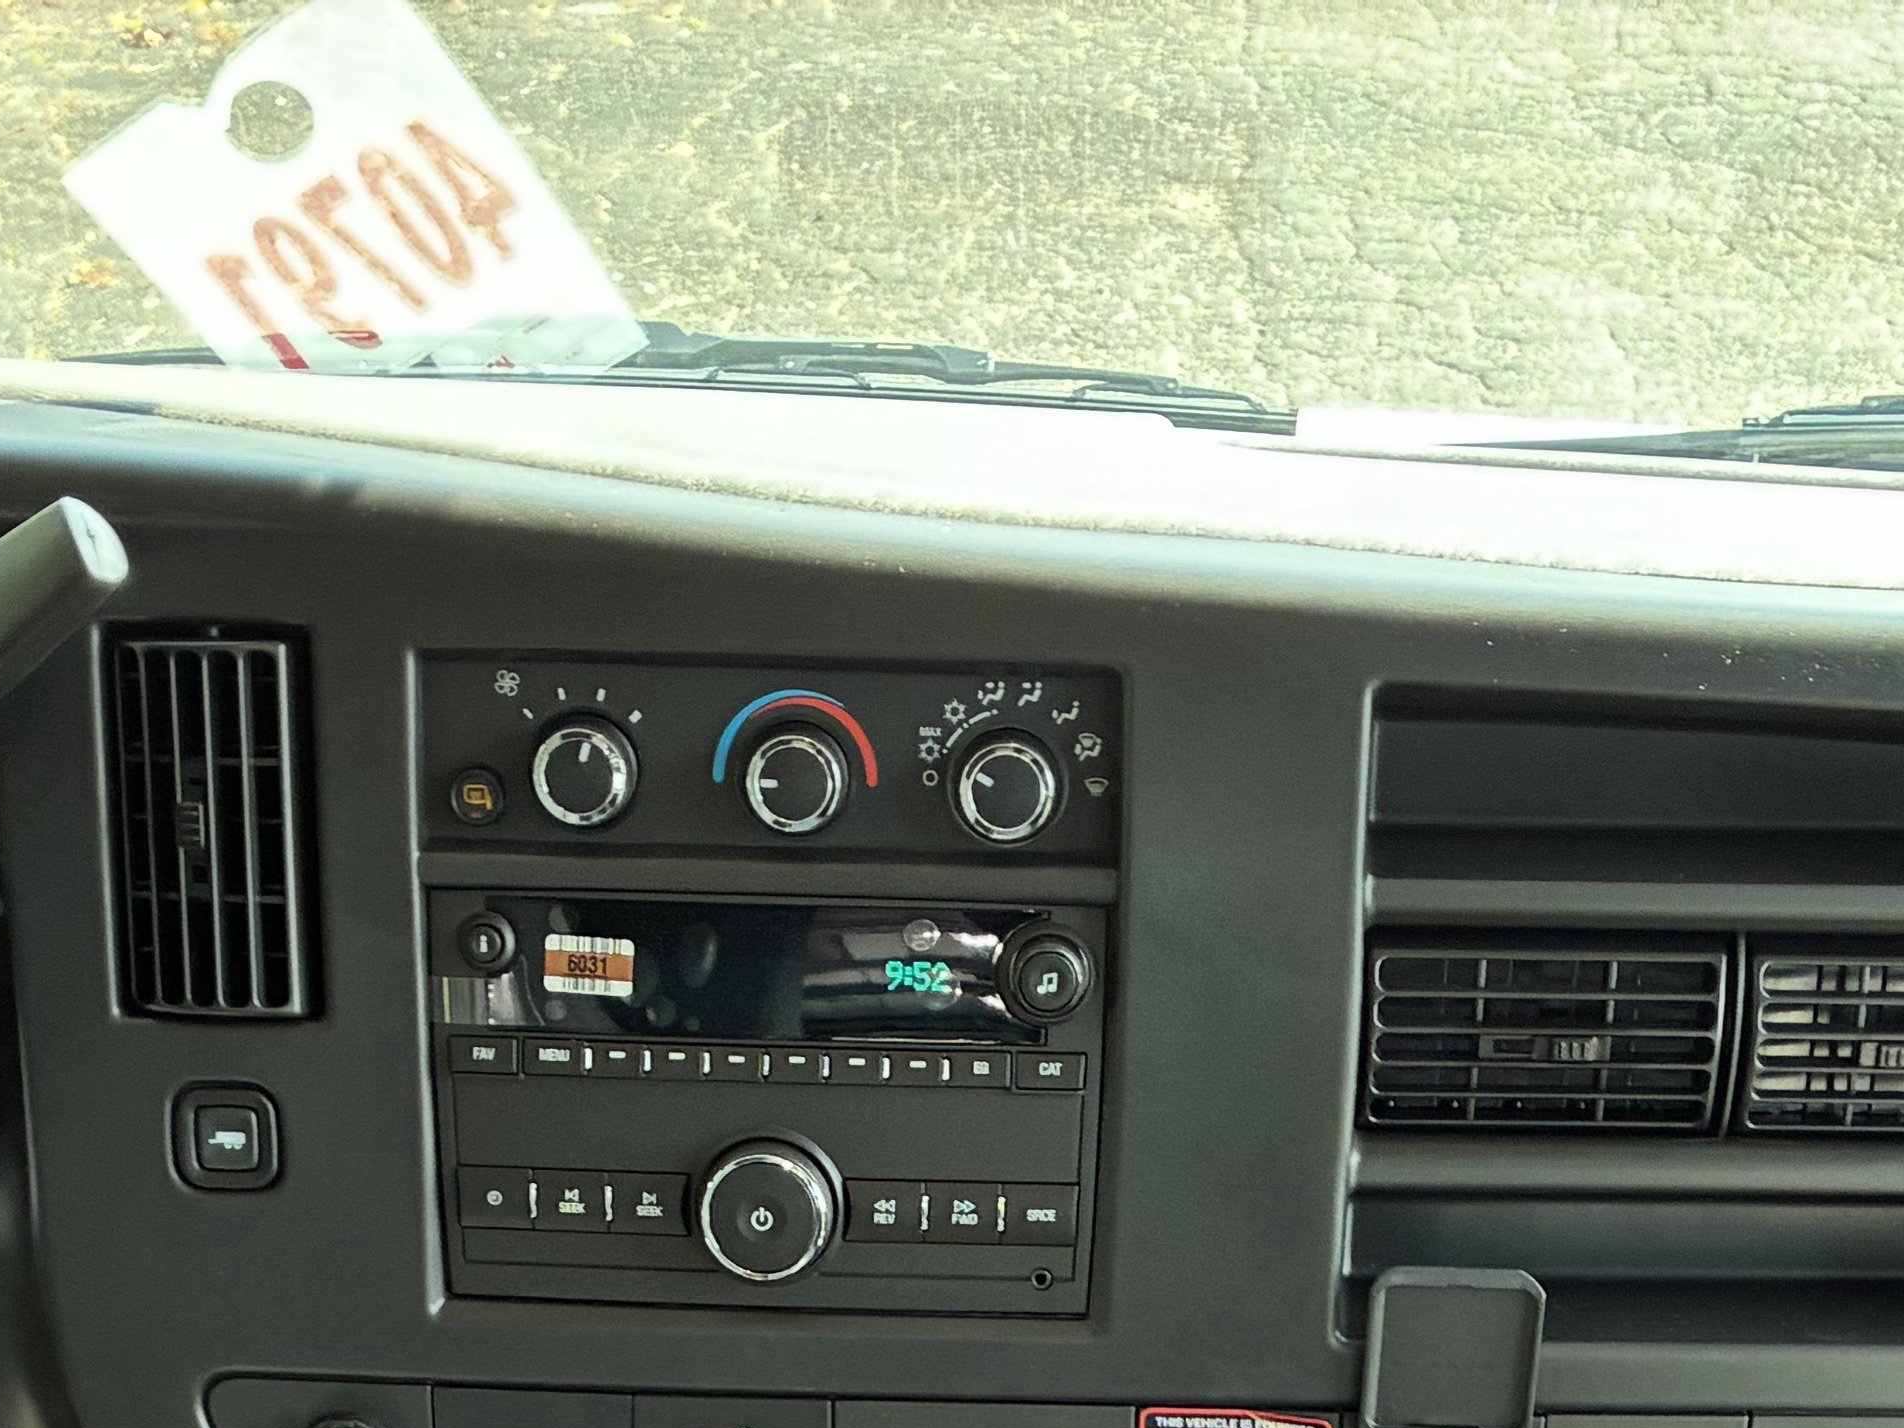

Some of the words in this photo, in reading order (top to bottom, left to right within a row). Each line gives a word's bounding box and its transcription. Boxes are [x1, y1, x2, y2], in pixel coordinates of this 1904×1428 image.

[567, 952, 610, 973] 6031
[885, 960, 955, 991] 9:52
[472, 1047, 497, 1060] FAV
[538, 1048, 571, 1062] MENU
[1038, 1062, 1064, 1076] CAT
[558, 1201, 586, 1214] SEEK
[636, 1204, 664, 1217] SEEK
[873, 1212, 896, 1225] REV
[1155, 1415, 1183, 1428] THIS
